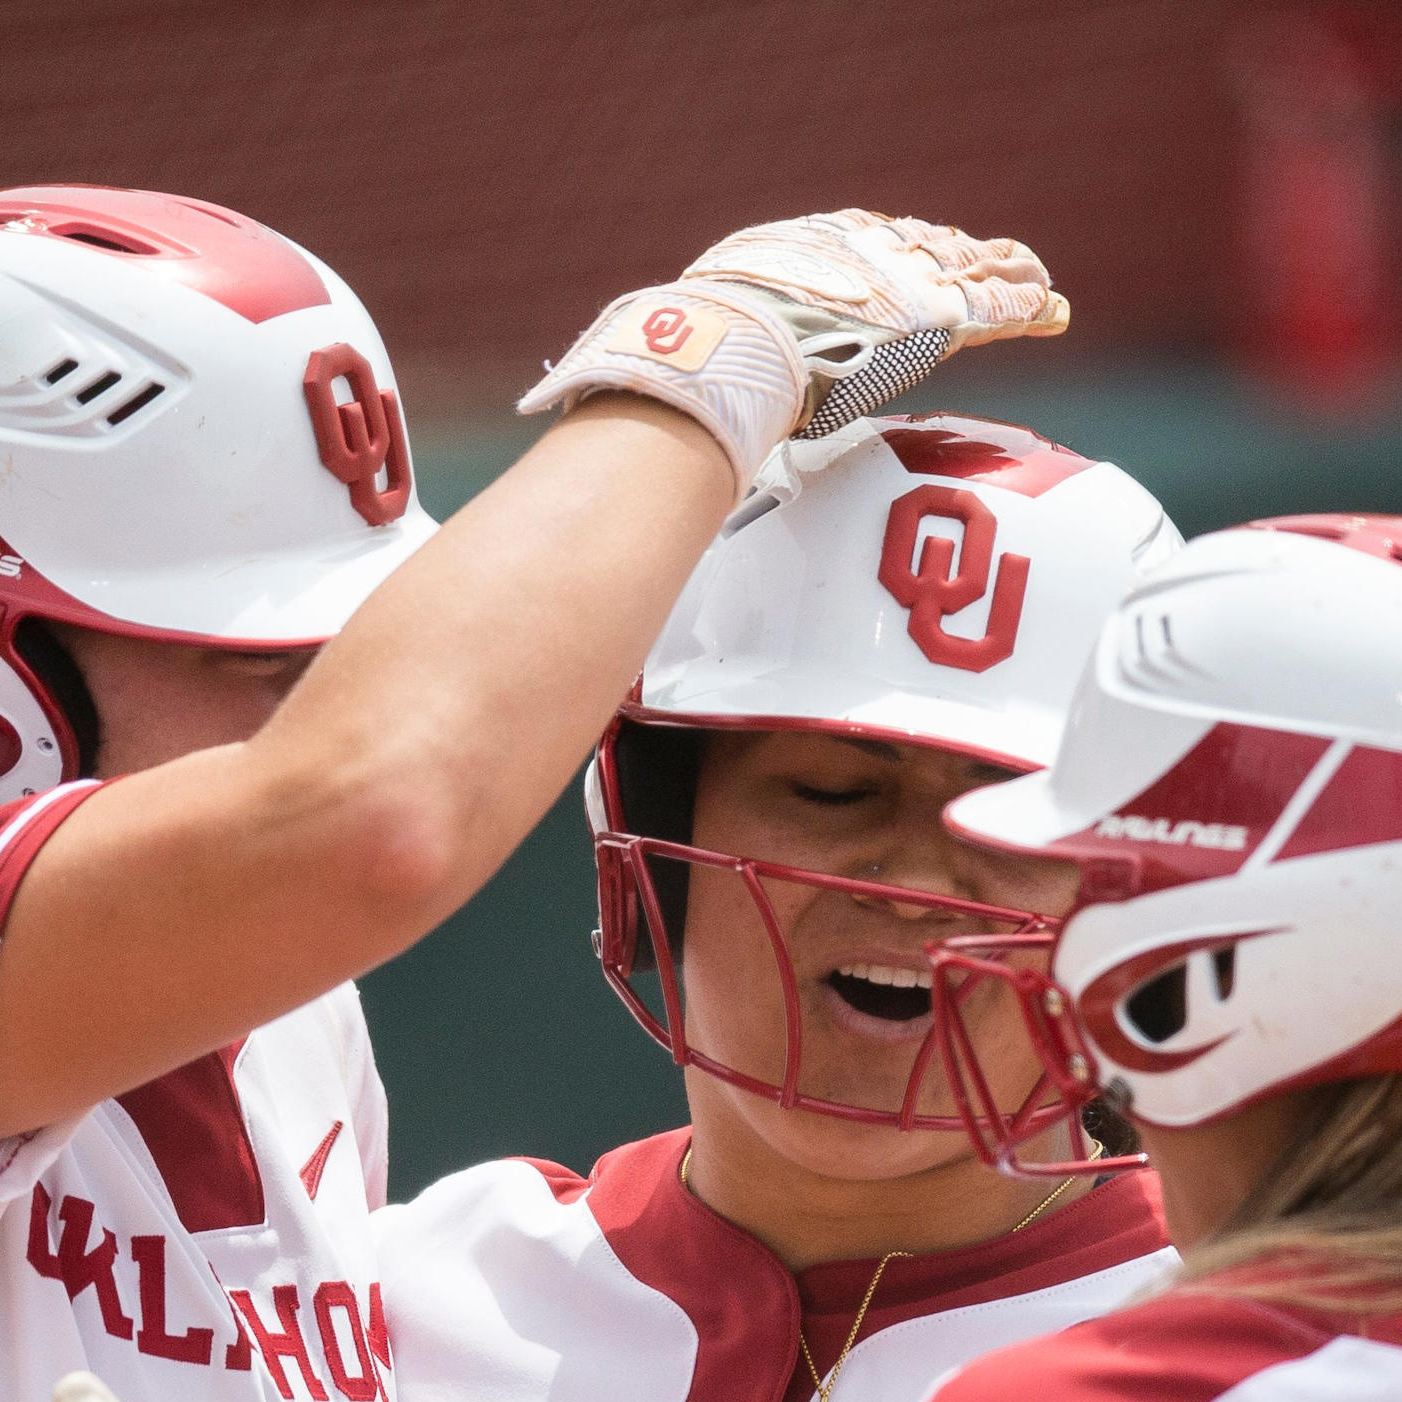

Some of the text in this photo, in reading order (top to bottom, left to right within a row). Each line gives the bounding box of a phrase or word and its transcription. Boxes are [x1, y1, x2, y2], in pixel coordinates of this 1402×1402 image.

[642, 307, 694, 355] OU
[303, 342, 412, 527] OU
[877, 483, 1031, 674] OU
